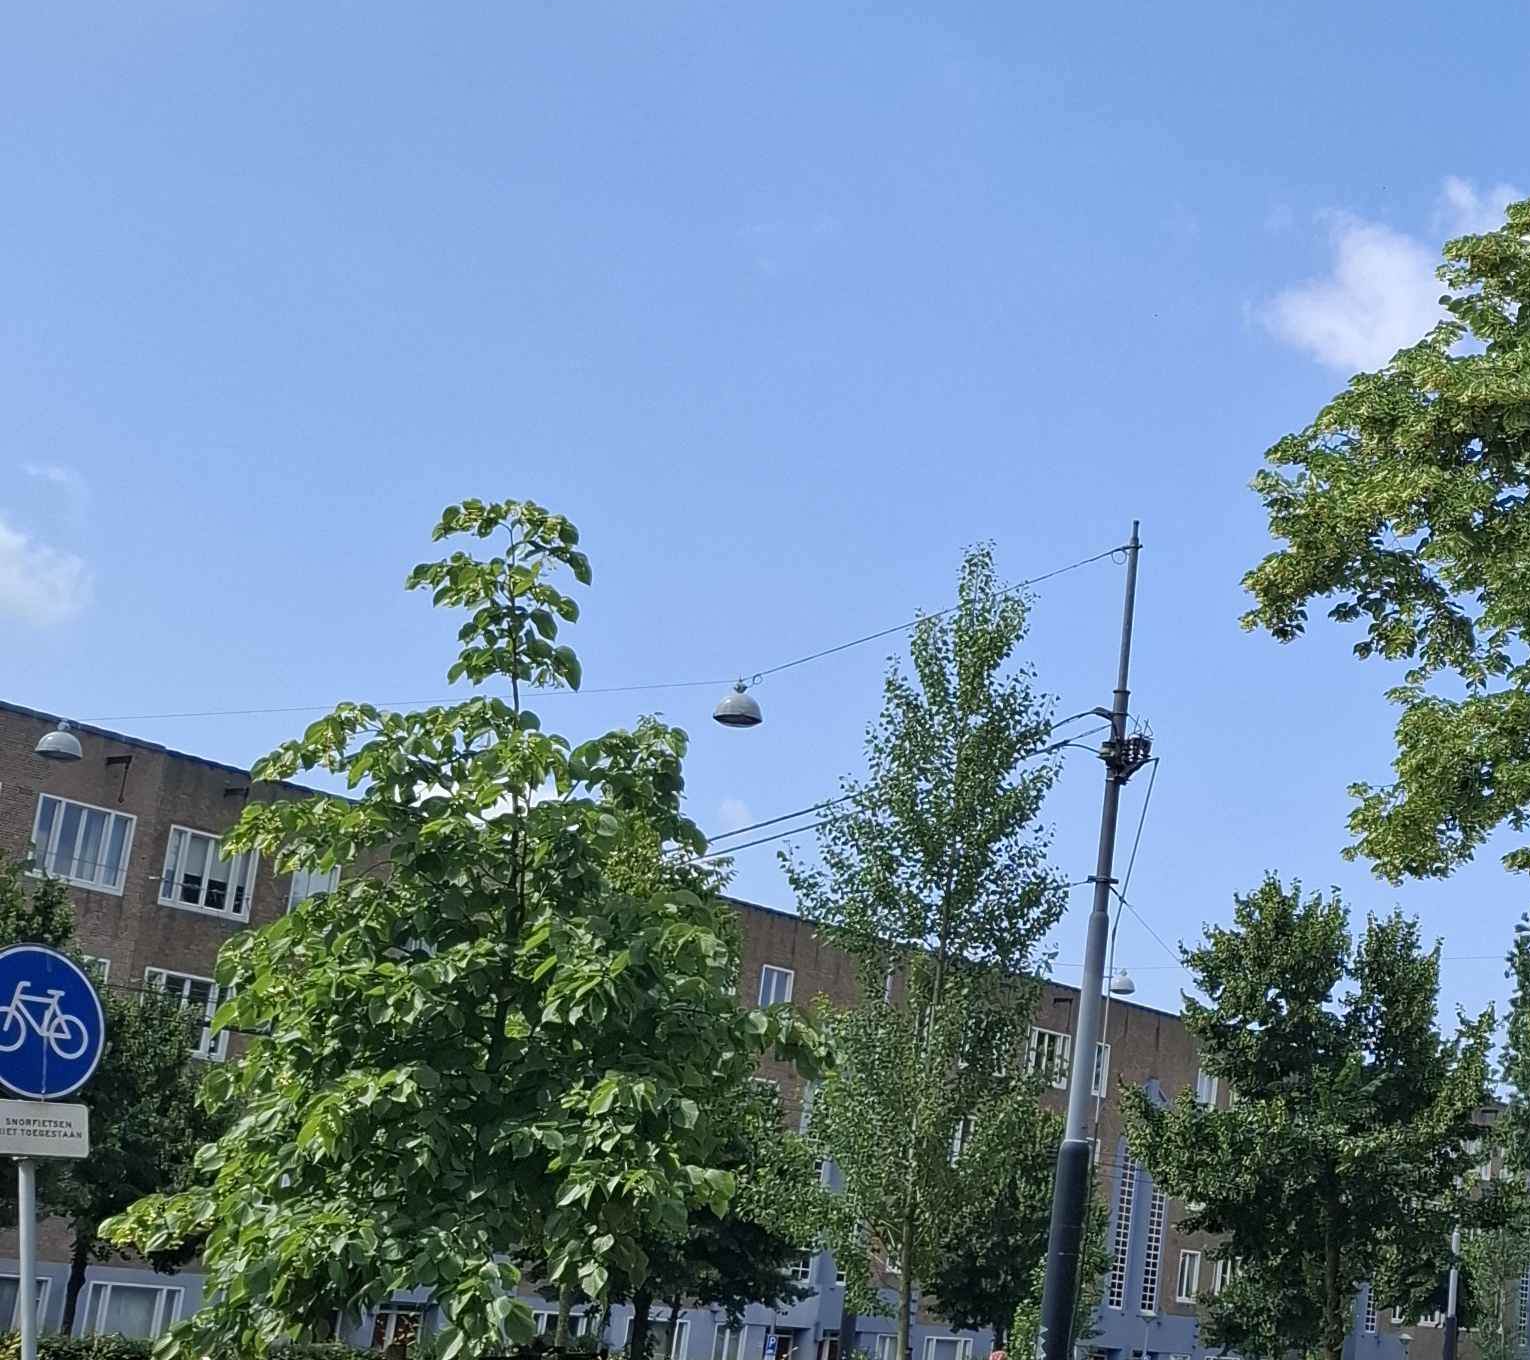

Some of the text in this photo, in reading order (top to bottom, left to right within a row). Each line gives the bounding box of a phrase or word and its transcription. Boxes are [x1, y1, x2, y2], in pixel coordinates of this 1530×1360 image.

[6, 1118, 72, 1128] SNORFIETSEN
[0, 1128, 82, 1138] IET TOEGESTAAN
